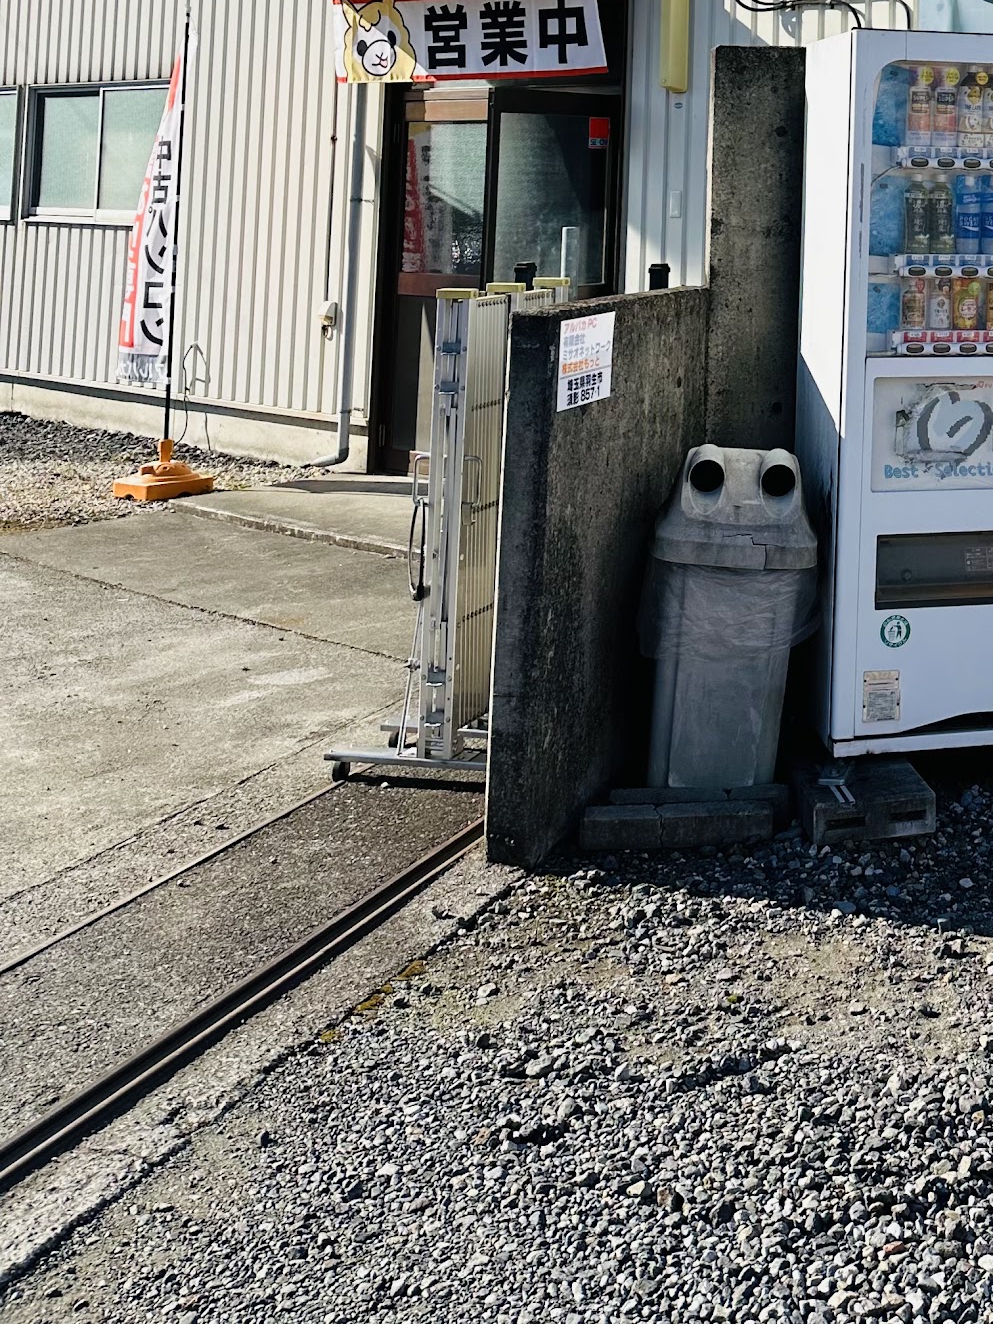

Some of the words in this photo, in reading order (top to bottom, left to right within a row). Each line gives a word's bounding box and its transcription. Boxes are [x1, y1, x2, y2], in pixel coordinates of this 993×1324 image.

[563, 333, 586, 348] 有限会社
[567, 371, 603, 392] 埼玉県羽生市
[884, 464, 919, 479] Best
